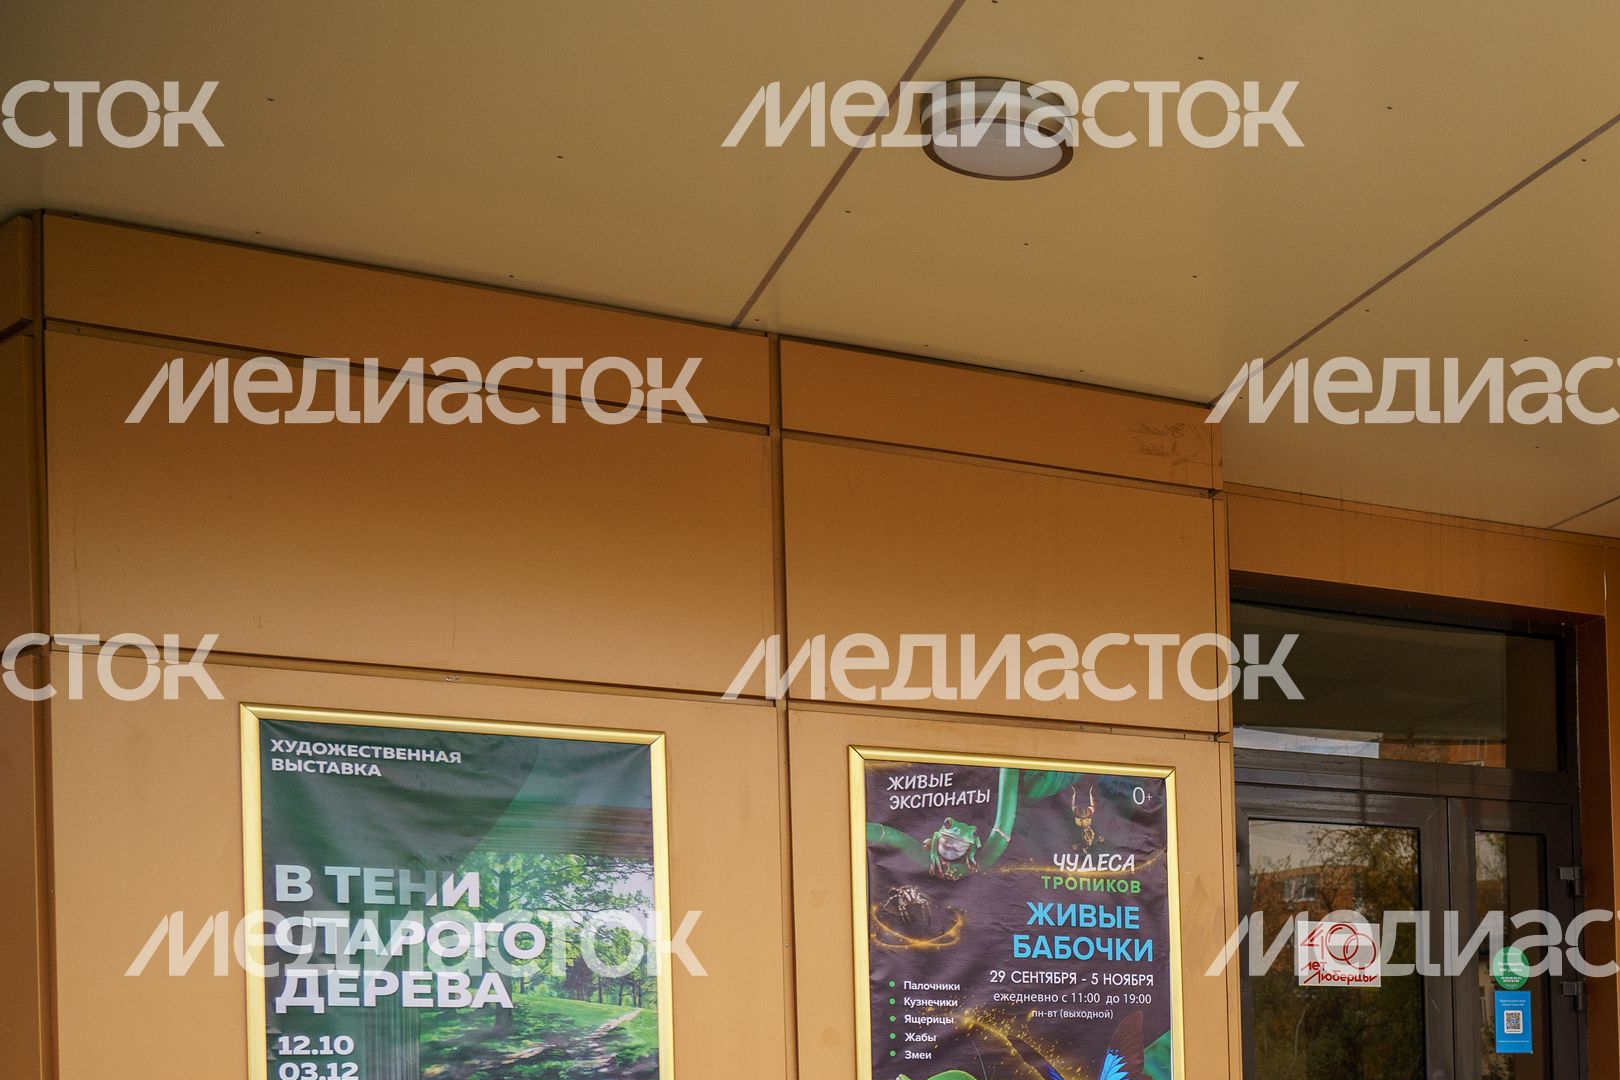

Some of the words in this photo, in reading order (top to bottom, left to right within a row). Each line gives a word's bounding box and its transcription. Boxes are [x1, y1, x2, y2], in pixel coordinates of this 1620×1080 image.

[270, 739, 462, 764] ХУДОЖЕСТВЕННАЯ
[271, 758, 382, 777] ВЫСТАВКА
[886, 772, 953, 792] ЖИВЫЕ
[889, 788, 991, 810] ЭКСПОНАТЫ
[1132, 786, 1153, 806] 0+
[1053, 853, 1136, 873] ЧУДЕСА
[274, 865, 314, 902] В
[325, 866, 481, 907] ТЕНИ
[1041, 875, 1141, 894] ТРОПИКОВ
[1026, 902, 1140, 930] ЖИВЫЕ
[275, 917, 546, 960] СТАРОГО
[1013, 934, 1153, 962] БАБОЧКИ
[903, 981, 961, 992] Палочники
[989, 970, 1006, 984] 29
[1011, 971, 1077, 985] СЕНТЯБРЯ
[1090, 973, 1099, 985] 5
[1103, 973, 1154, 987] НОЯБРЯ
[275, 970, 514, 1014] ДЕРЕВА
[993, 992, 1059, 1004] ежедневно
[1061, 994, 1068, 1002] с
[1071, 992, 1100, 1003] 11:00
[1105, 994, 1120, 1005] до
[1123, 993, 1152, 1005] 19:00
[903, 997, 958, 1008] Кузнечики
[904, 1014, 954, 1026] Ящерицы
[1031, 1009, 1058, 1019] пн-вт
[1060, 1008, 1114, 1020] (выходной)
[277, 1035, 355, 1056] 12.10
[904, 1032, 937, 1043] Жабы
[904, 1050, 932, 1060] Змеи
